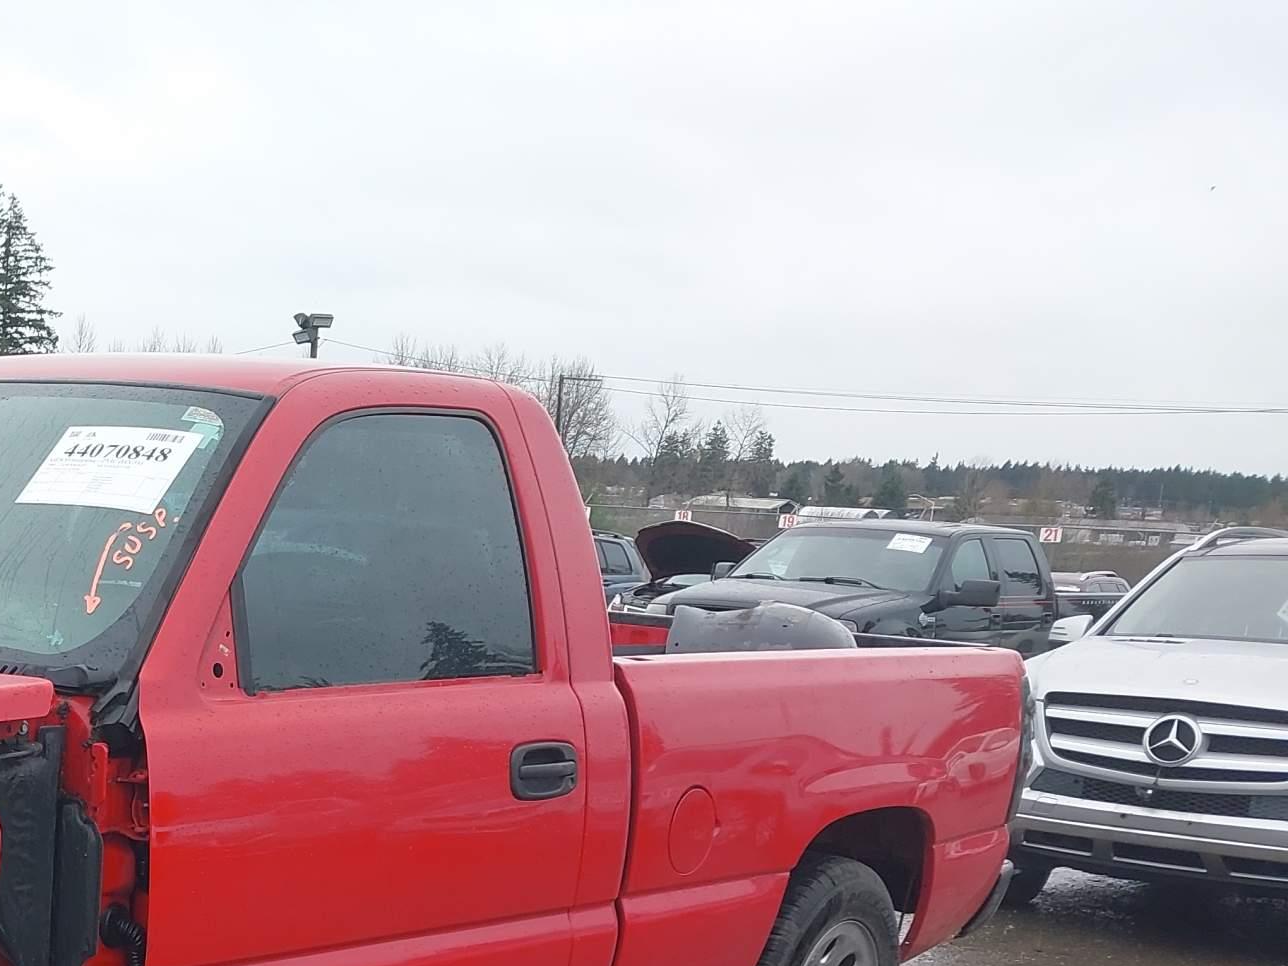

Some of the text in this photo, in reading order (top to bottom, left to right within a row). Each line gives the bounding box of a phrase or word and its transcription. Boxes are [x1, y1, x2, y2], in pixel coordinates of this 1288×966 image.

[64, 443, 172, 463] 44070848
[782, 515, 795, 528] 19
[1043, 528, 1058, 541] 21
